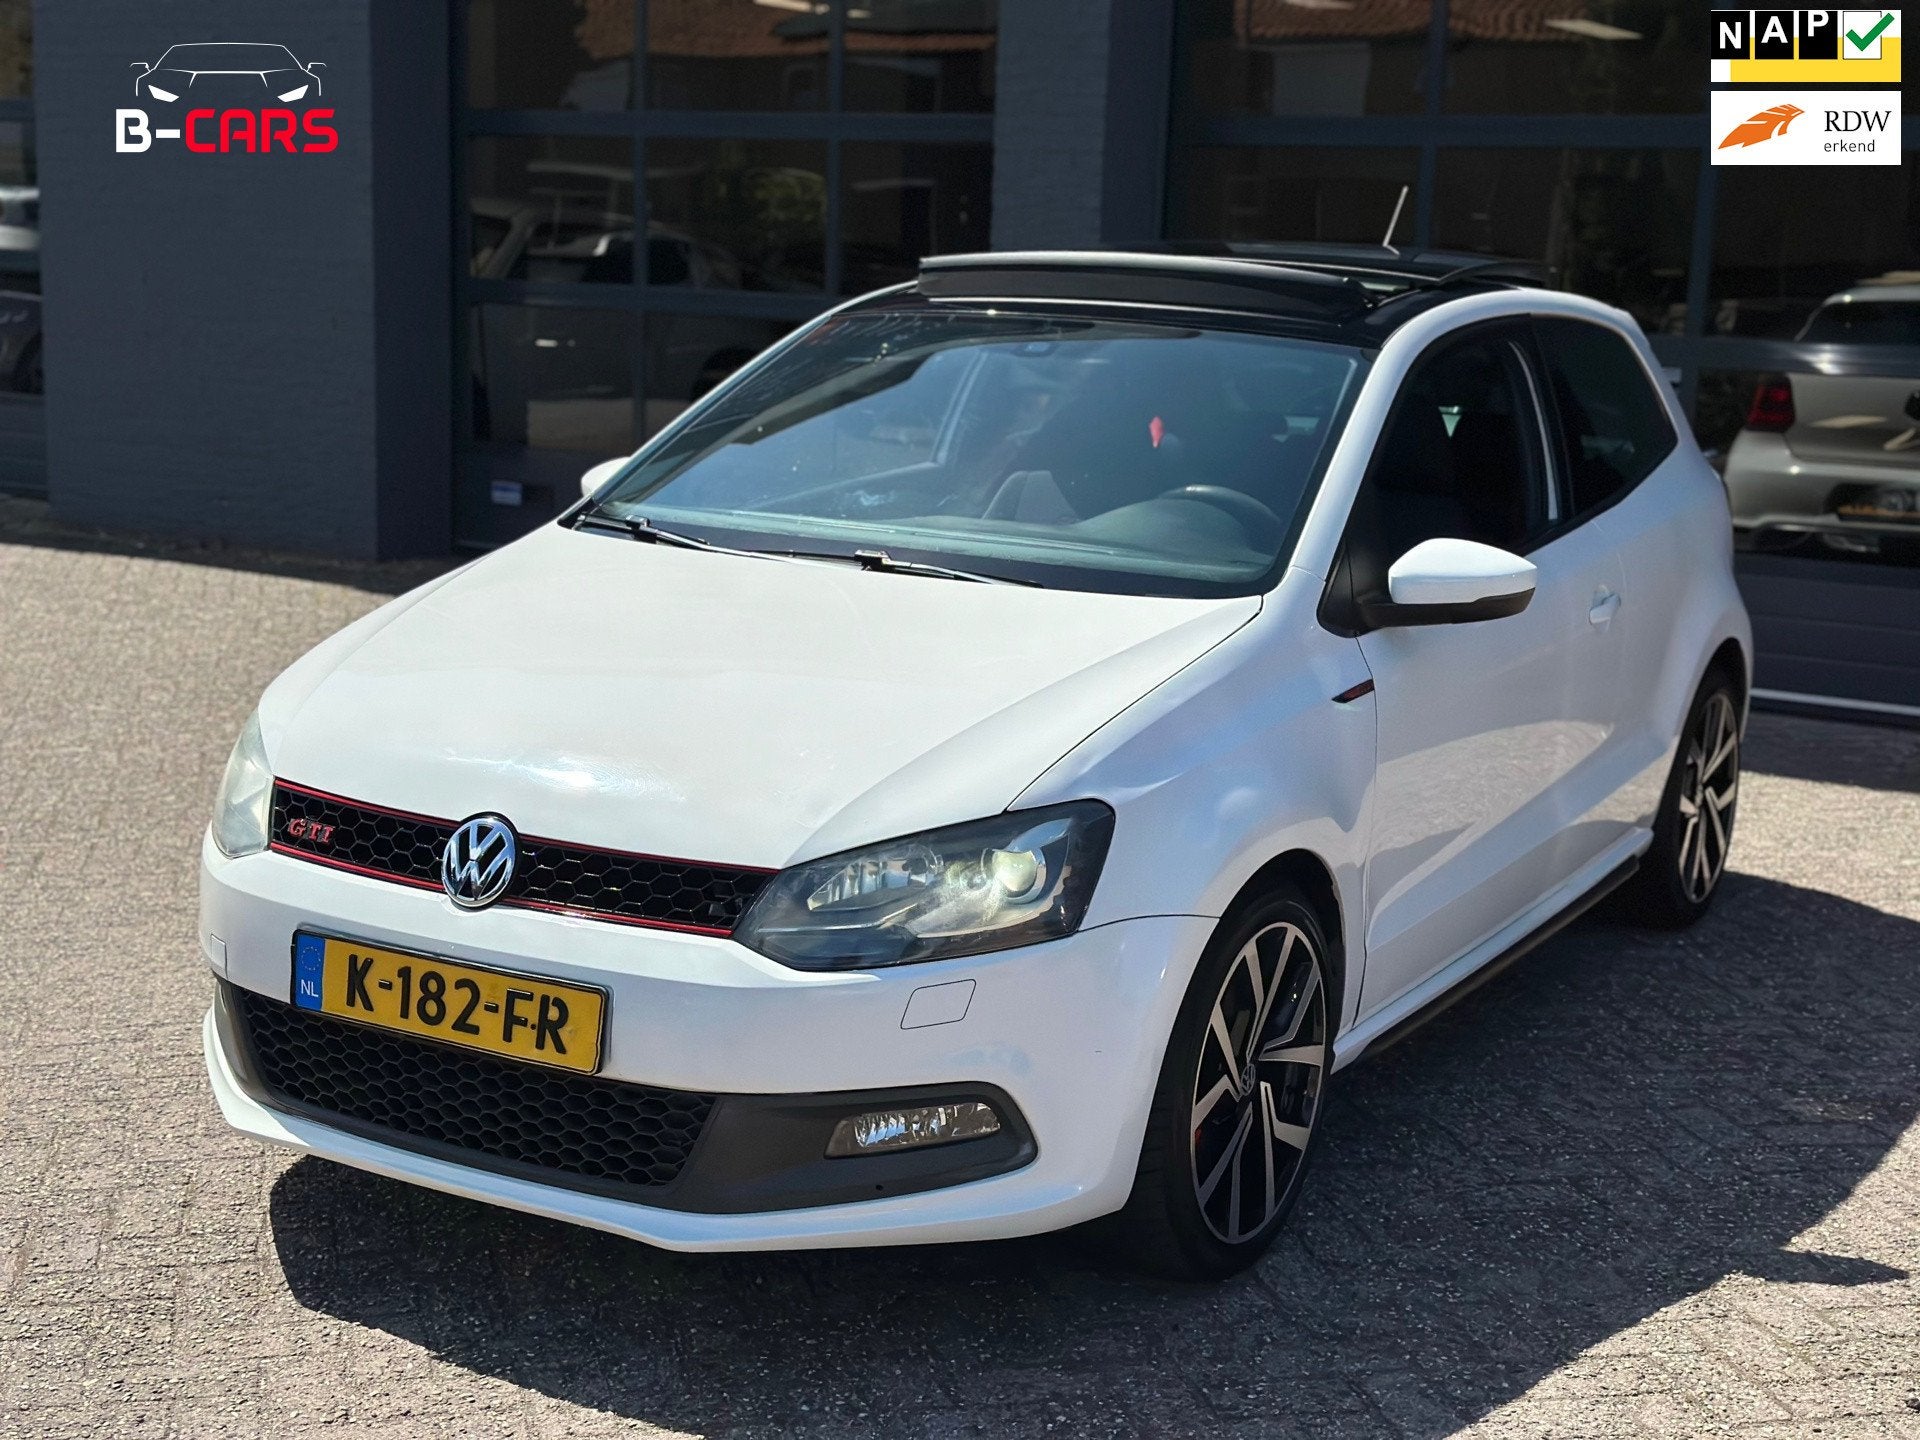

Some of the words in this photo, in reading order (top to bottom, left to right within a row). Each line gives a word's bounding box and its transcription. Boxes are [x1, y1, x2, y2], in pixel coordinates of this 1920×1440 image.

[289, 818, 334, 844] GTI
[300, 979, 319, 998] NL
[346, 953, 569, 1054] K-182-FR
